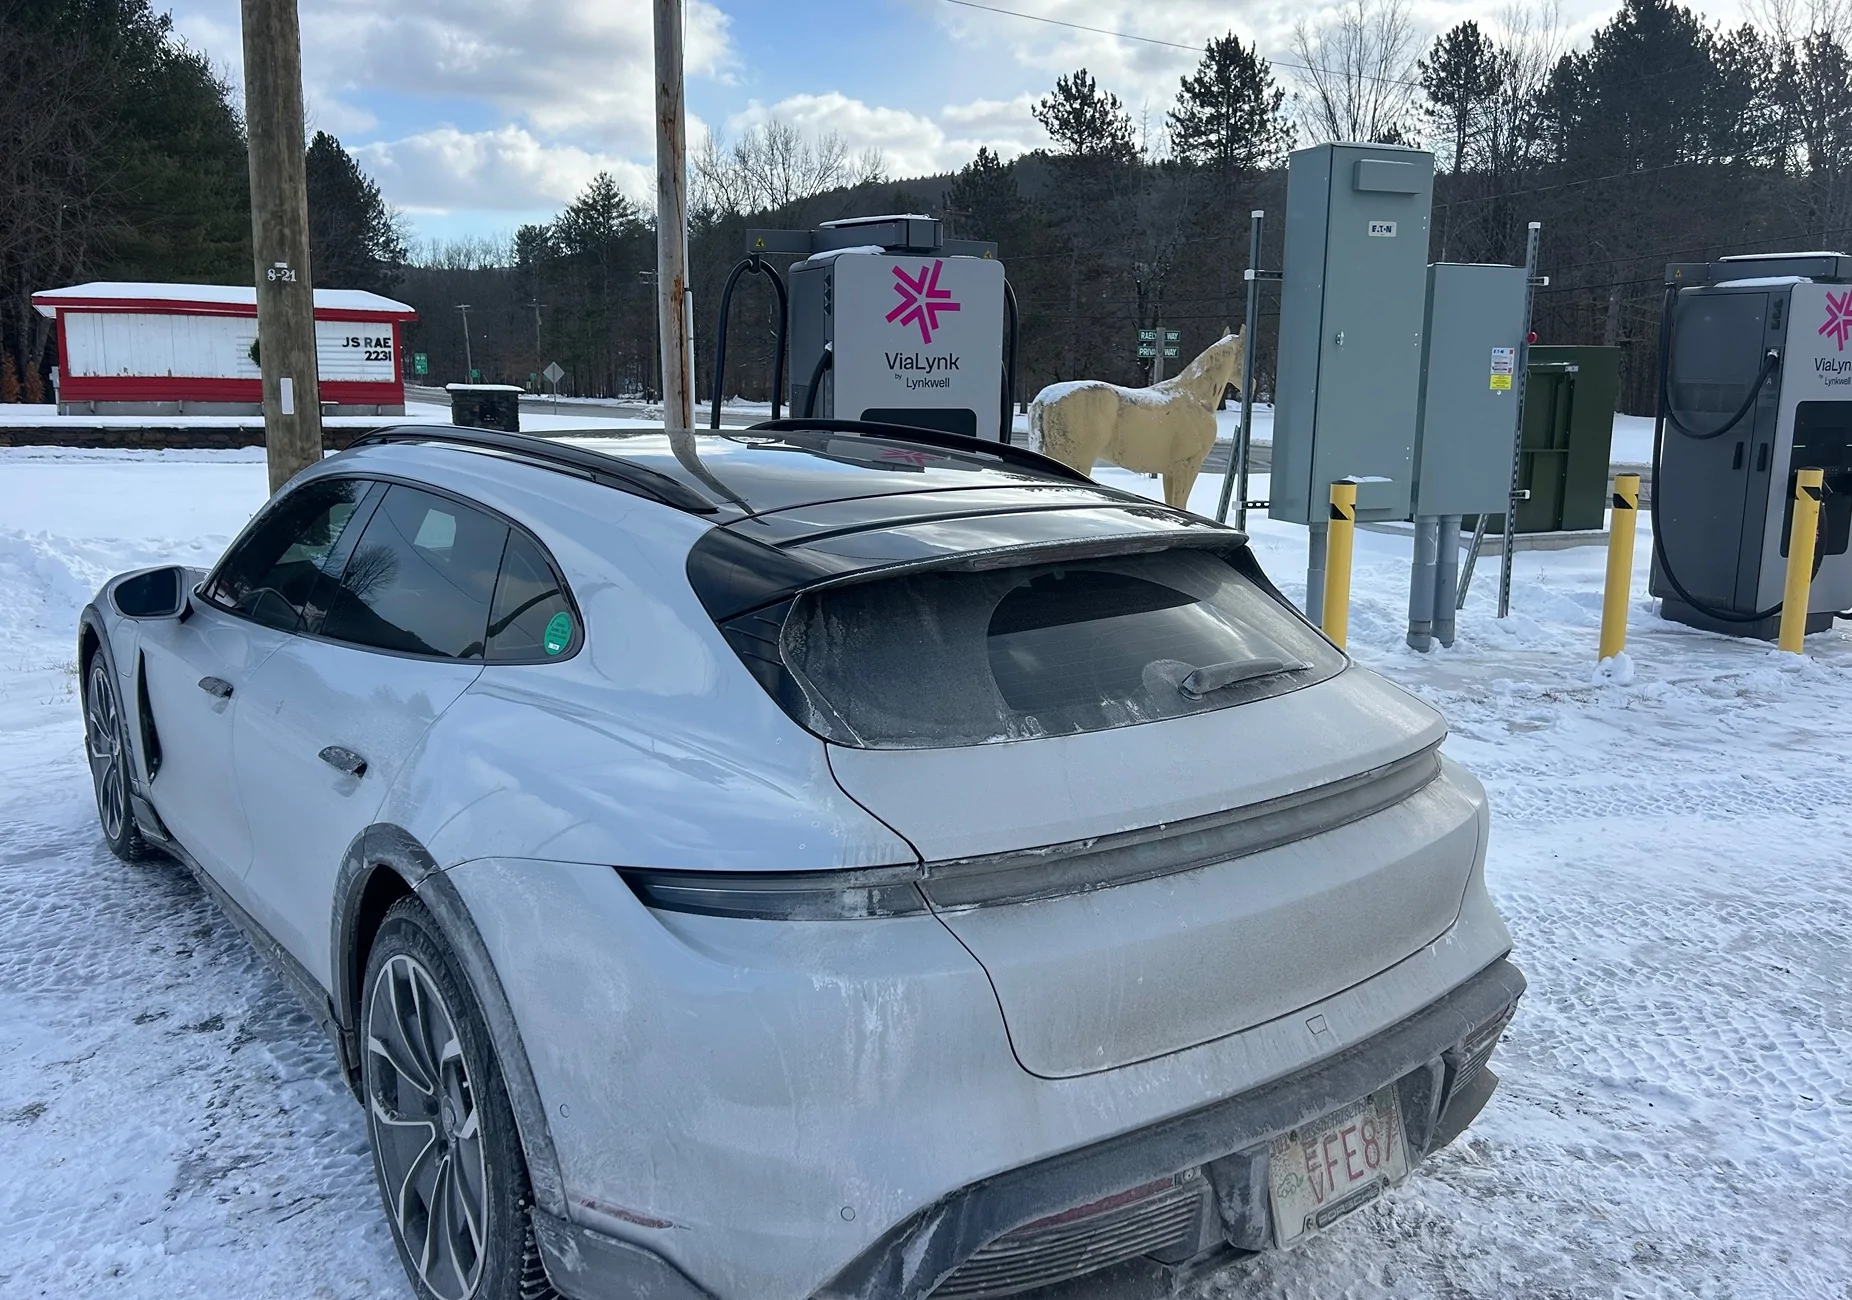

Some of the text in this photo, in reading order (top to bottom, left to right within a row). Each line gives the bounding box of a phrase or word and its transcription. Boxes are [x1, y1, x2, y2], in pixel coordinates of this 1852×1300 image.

[267, 268, 297, 282] 8-21
[341, 336, 391, 348] JS RAE
[1166, 332, 1179, 340] WAY
[364, 350, 392, 361] 2231
[1164, 348, 1177, 356] WAY
[884, 352, 960, 374] ViaLynk
[1814, 357, 1852, 374] ViaLyn
[906, 377, 950, 390] Lynkwell
[1824, 376, 1851, 387] Lynkwell
